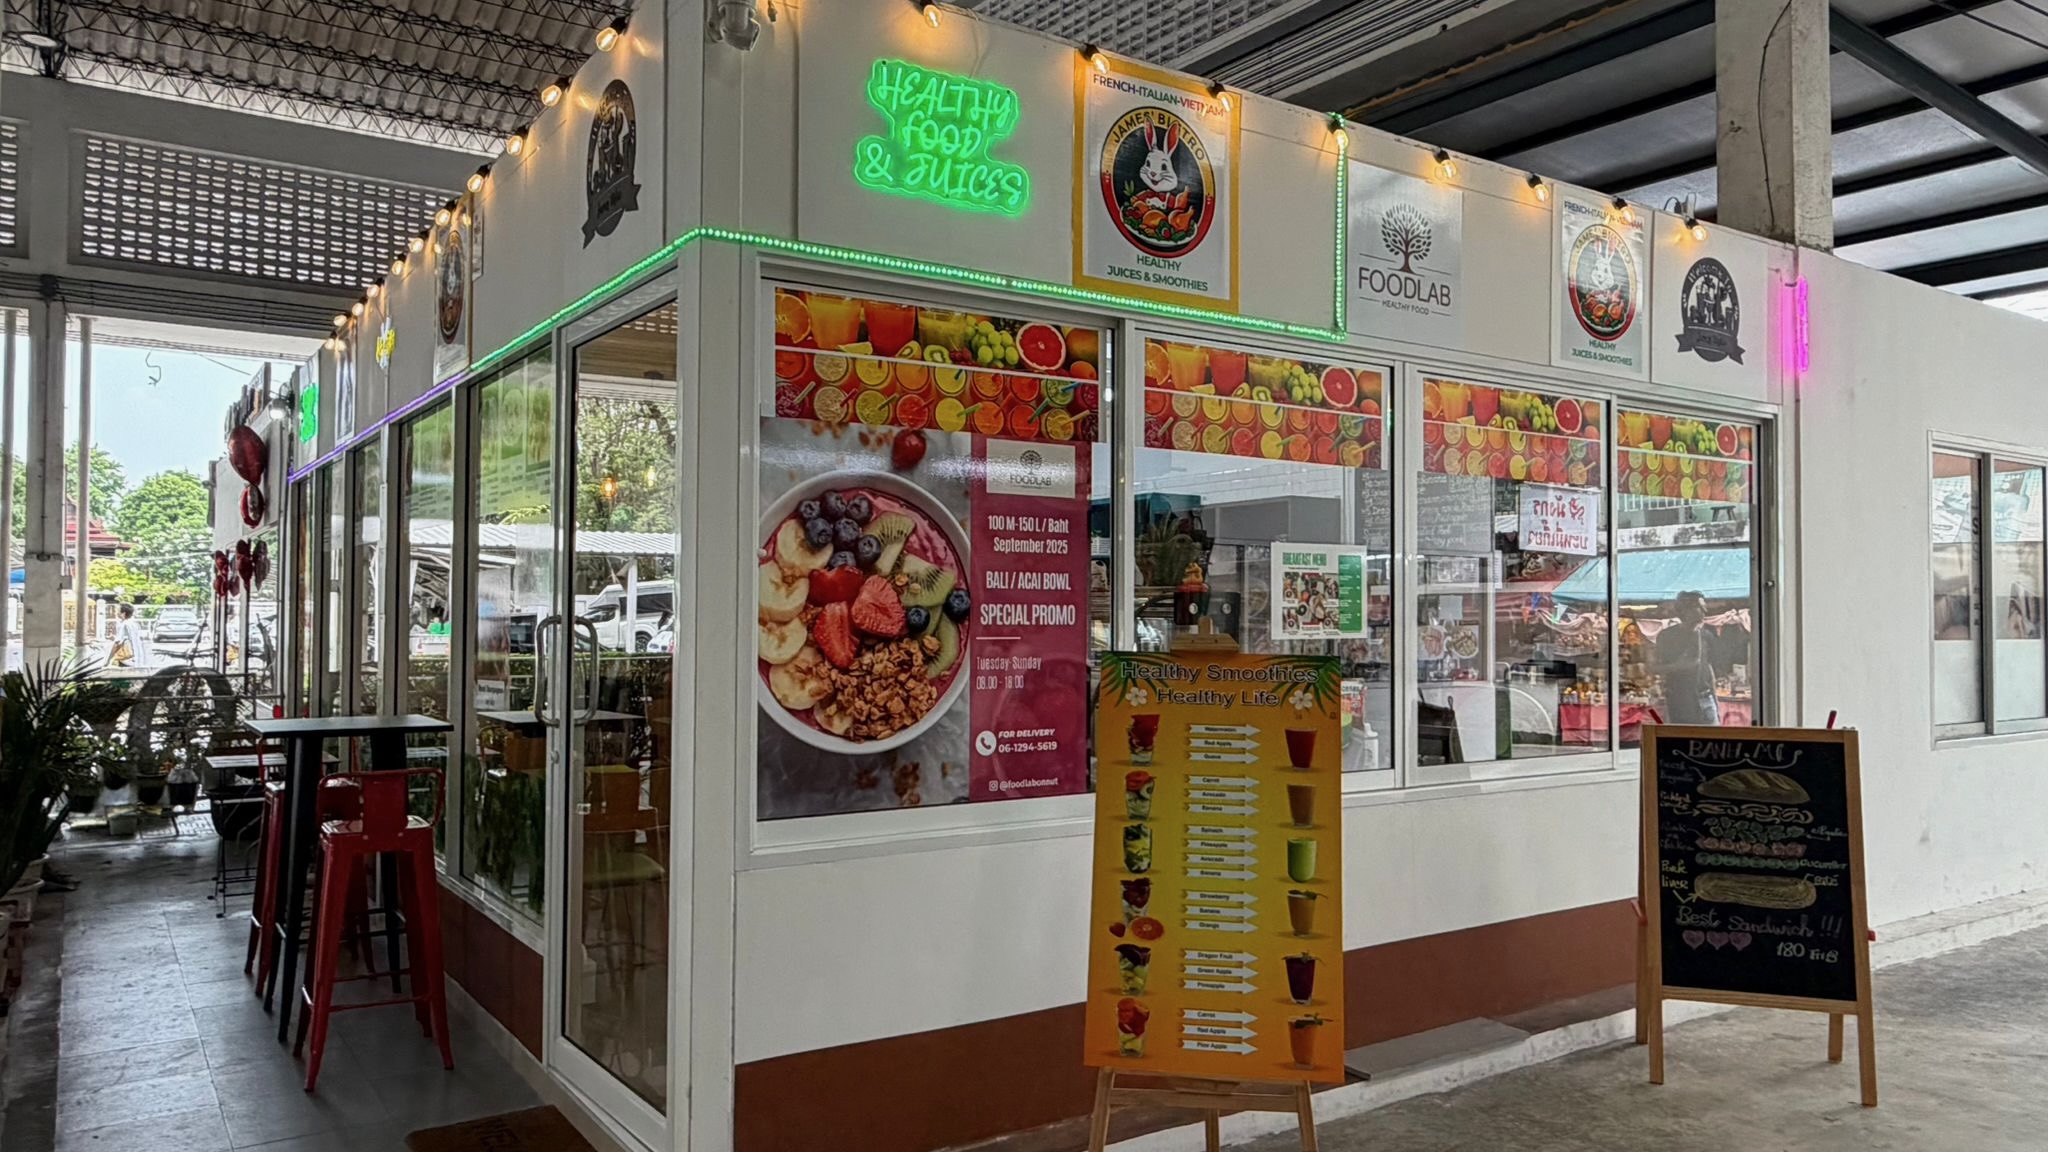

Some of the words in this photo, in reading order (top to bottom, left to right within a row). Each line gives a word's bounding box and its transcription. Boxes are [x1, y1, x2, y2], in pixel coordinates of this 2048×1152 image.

[877, 66, 1010, 131] HEALTHY
[902, 110, 981, 158] FOOD
[865, 143, 893, 182] &
[905, 153, 1022, 205] JUICES
[1137, 254, 1182, 271] HEALTHY
[1107, 265, 1142, 281] JUICES
[1144, 271, 1151, 282] &
[1152, 273, 1208, 291] SMOOTHIES
[1358, 267, 1451, 306] FOODLAB
[1382, 300, 1410, 312] HEALTHY
[1411, 305, 1429, 316] FOOD
[1589, 339, 1616, 351] HEALTHY
[1010, 475, 1052, 487] FOODLAB
[988, 515, 1005, 530] 100
[1036, 517, 1041, 532] L
[1042, 518, 1047, 532] /
[1048, 518, 1069, 534] Baht
[993, 536, 1045, 554] September
[1046, 539, 1068, 554] 2025
[986, 571, 1009, 589] BALI
[1010, 571, 1016, 589] /
[1017, 572, 1041, 590] ACAI
[1043, 573, 1071, 591] BOWL
[980, 604, 1030, 625] SPECIAL
[1032, 605, 1076, 625] PROMO
[1120, 661, 1200, 684] Healthy
[1207, 664, 1320, 684] Smoothies
[1157, 688, 1237, 709] Healthy
[1241, 690, 1280, 706] Life
[998, 730, 1015, 739] FOR
[1016, 728, 1056, 738] DELIVERY
[1674, 905, 1721, 928] Best
[1728, 914, 1814, 938] Sandwich
[1776, 942, 1806, 957] 180
